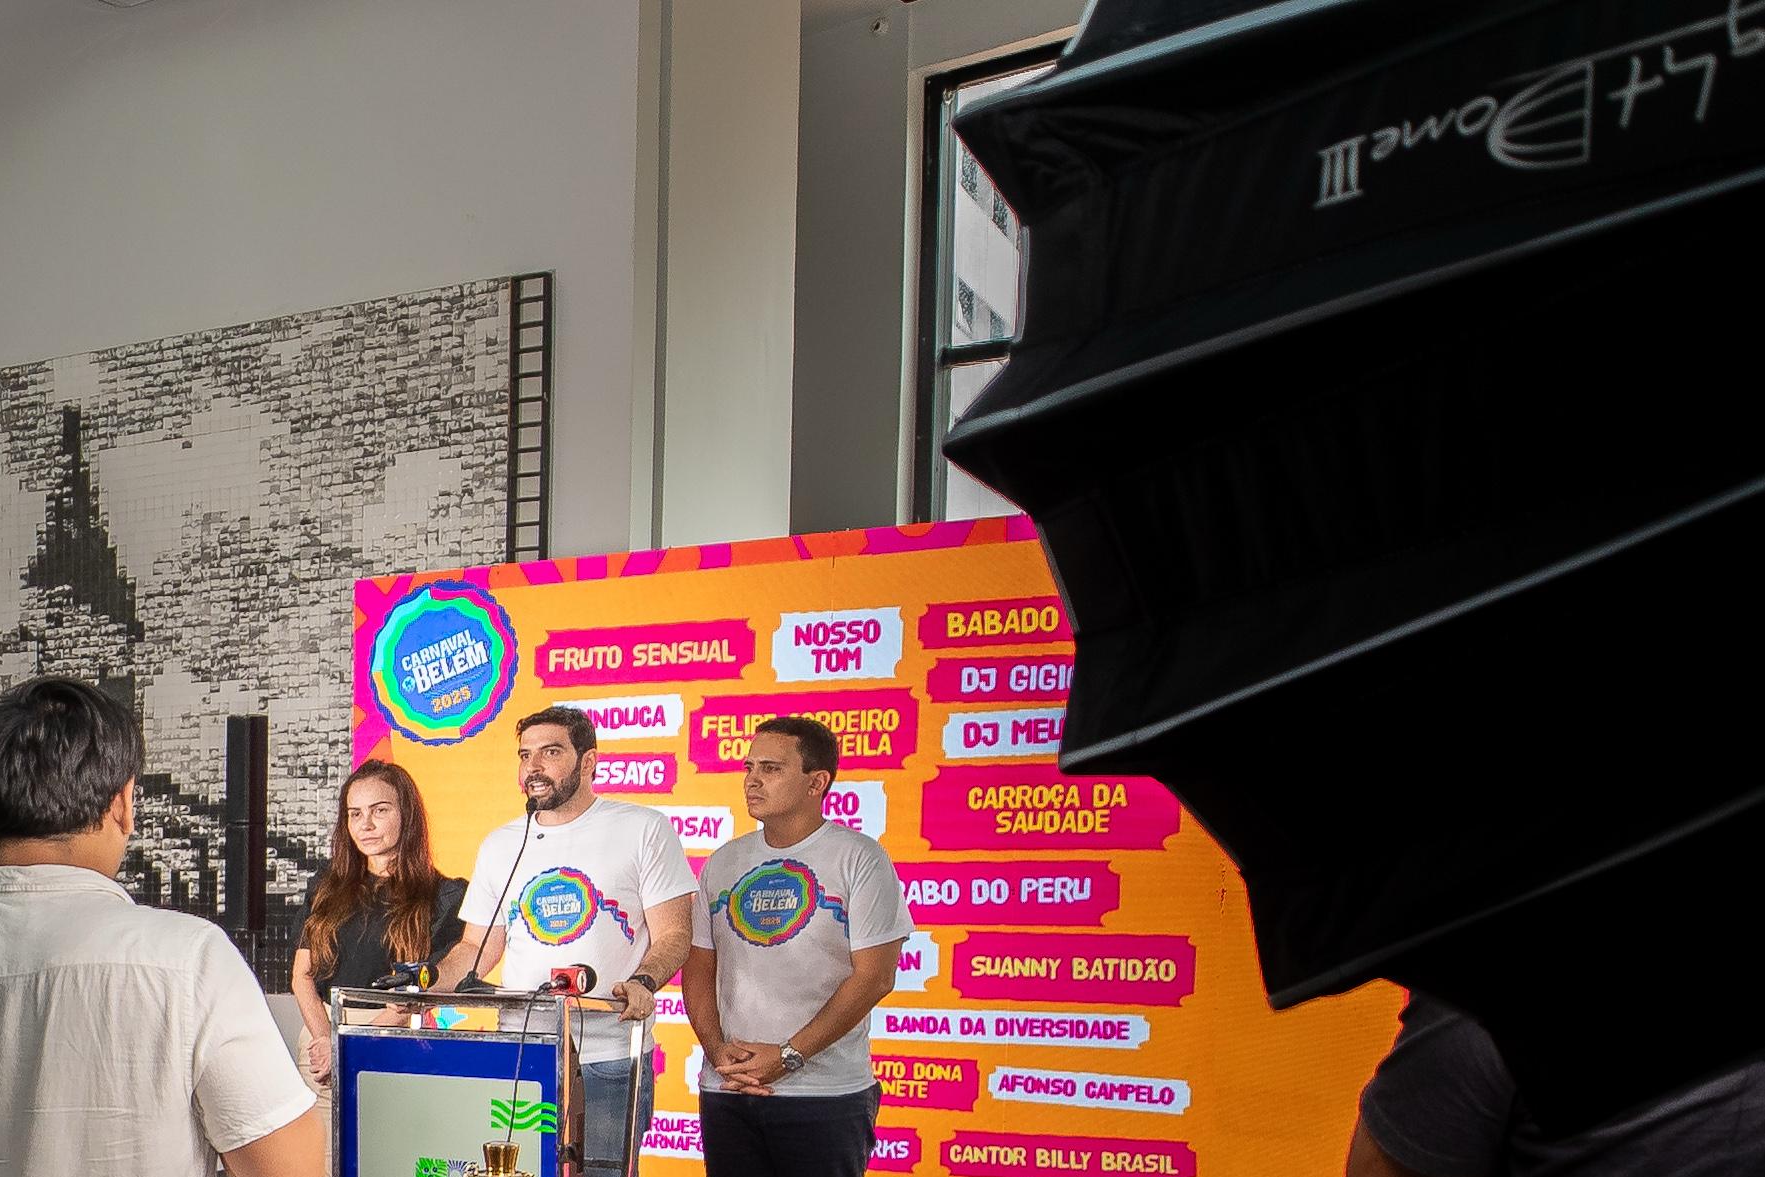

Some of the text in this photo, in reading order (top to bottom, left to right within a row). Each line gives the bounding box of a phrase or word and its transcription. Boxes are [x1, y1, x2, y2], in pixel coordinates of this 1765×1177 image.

[794, 619, 881, 647] NOSSO
[947, 606, 1059, 638] BABADO
[401, 629, 477, 671] CARNAVAL
[548, 638, 736, 673] FRUTO SENSUAL
[811, 647, 861, 674] TOM
[411, 640, 488, 694] BELÉM
[961, 666, 997, 693] DJ
[431, 686, 471, 713] 2025
[701, 713, 777, 738] FELIP
[963, 717, 1065, 749] DJ MEU
[837, 733, 893, 757] EILA
[592, 759, 666, 786] SSAYG
[968, 783, 1128, 812] CARROÇA DA
[670, 815, 724, 839] DSAY
[995, 810, 1110, 835] SAUDADE
[971, 878, 1010, 905] DO
[1020, 876, 1092, 904] PERU
[971, 955, 1177, 982] SUANNY BATIDÃO
[885, 1014, 1131, 1041] BANDA DA DIVERSIDADE
[913, 1062, 963, 1082] DONA
[878, 1079, 929, 1099] NETE
[998, 1073, 1175, 1106] AFONSO CAMPELO
[870, 1139, 910, 1159] RKS
[949, 1144, 1179, 1175] CANTOR BILLY BRASIL
